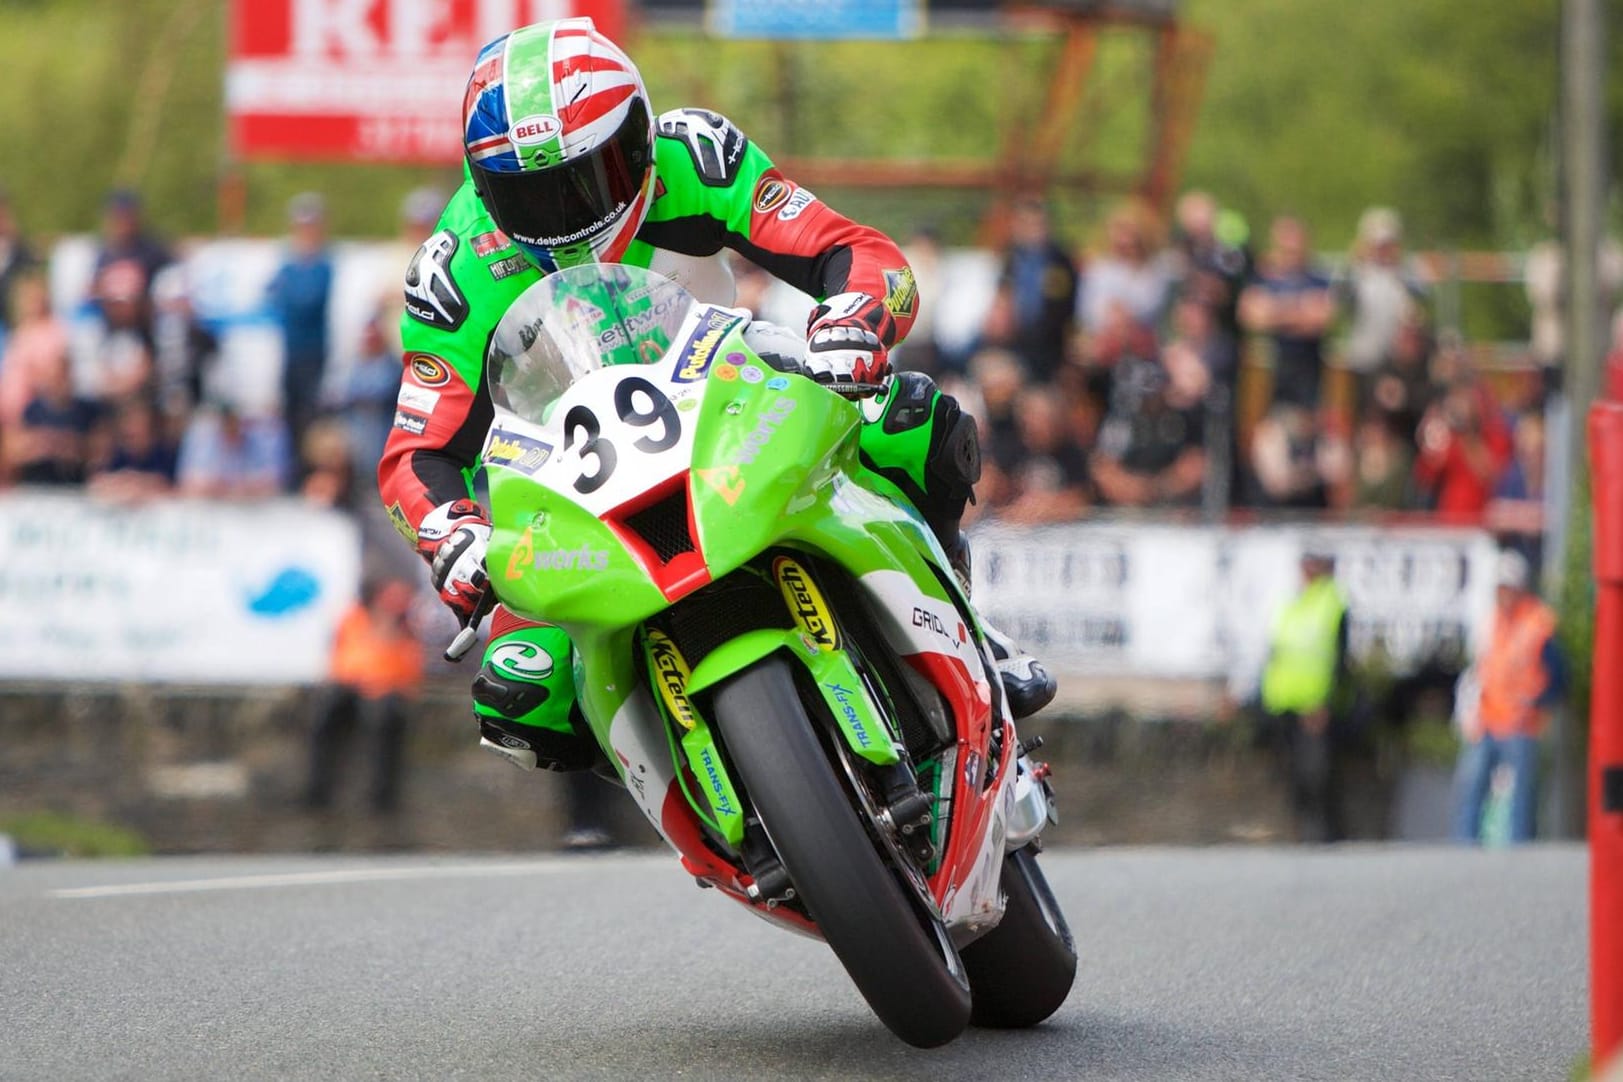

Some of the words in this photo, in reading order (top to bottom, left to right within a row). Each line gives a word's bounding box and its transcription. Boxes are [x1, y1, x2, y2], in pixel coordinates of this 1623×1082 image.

[516, 121, 553, 139] BELL
[513, 201, 626, 246] www.delphcontrols.co.uk
[564, 377, 682, 494] 39
[825, 683, 872, 749] TRANS-FIX
[700, 748, 737, 816] TRANS-FIX
